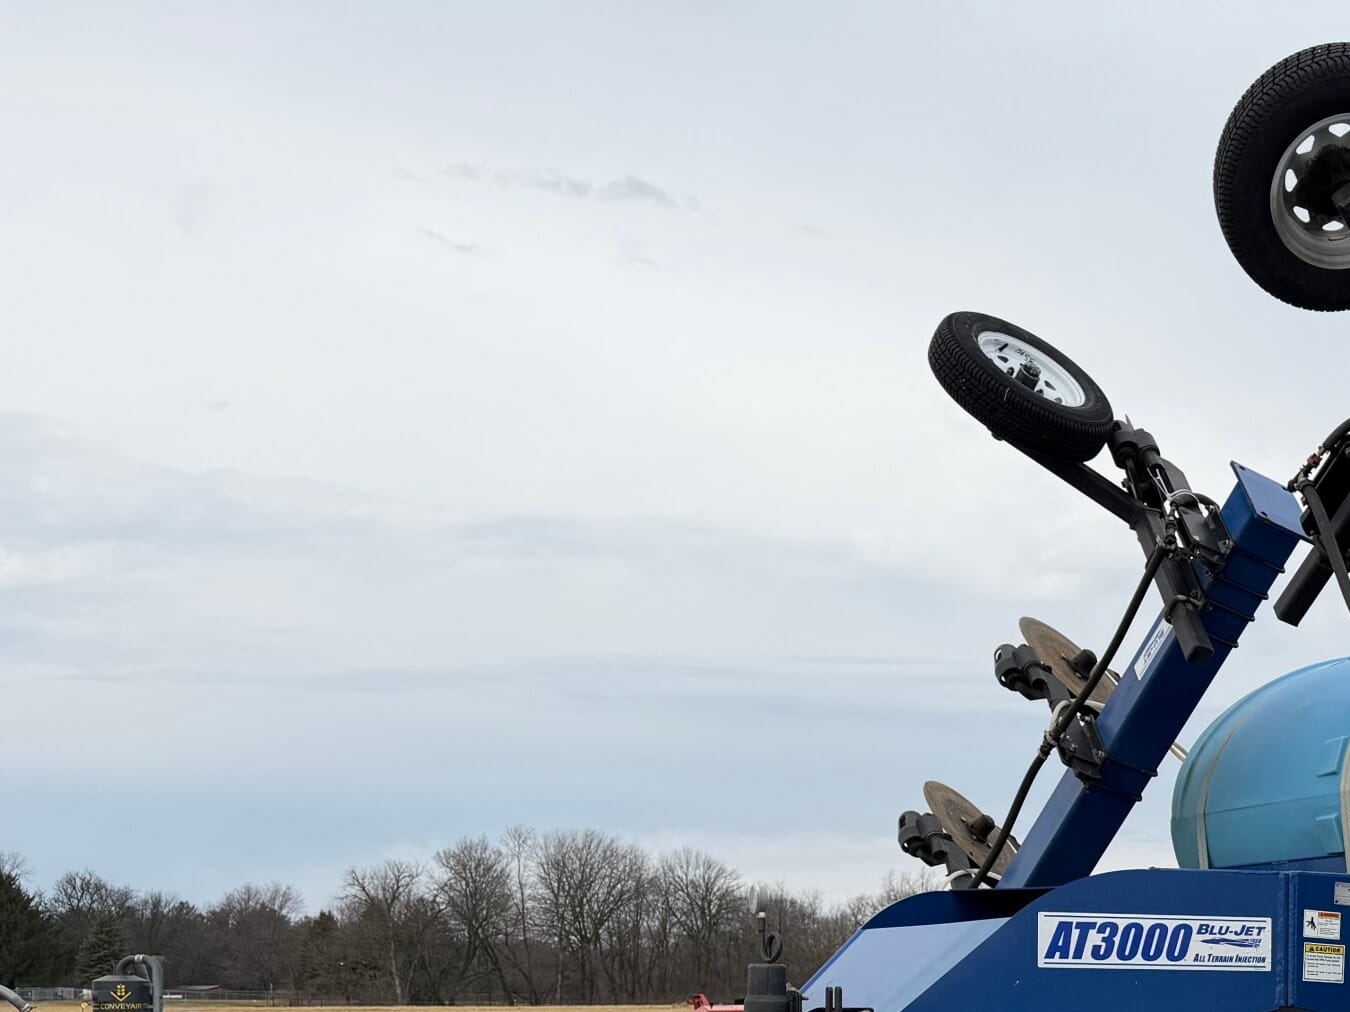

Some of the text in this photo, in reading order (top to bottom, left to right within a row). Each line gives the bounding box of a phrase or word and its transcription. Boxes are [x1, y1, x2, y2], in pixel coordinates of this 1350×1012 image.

[1044, 920, 1266, 963] AT3000 BLU-JET
[1193, 953, 1267, 964] ALL TERRAIN INJECTION
